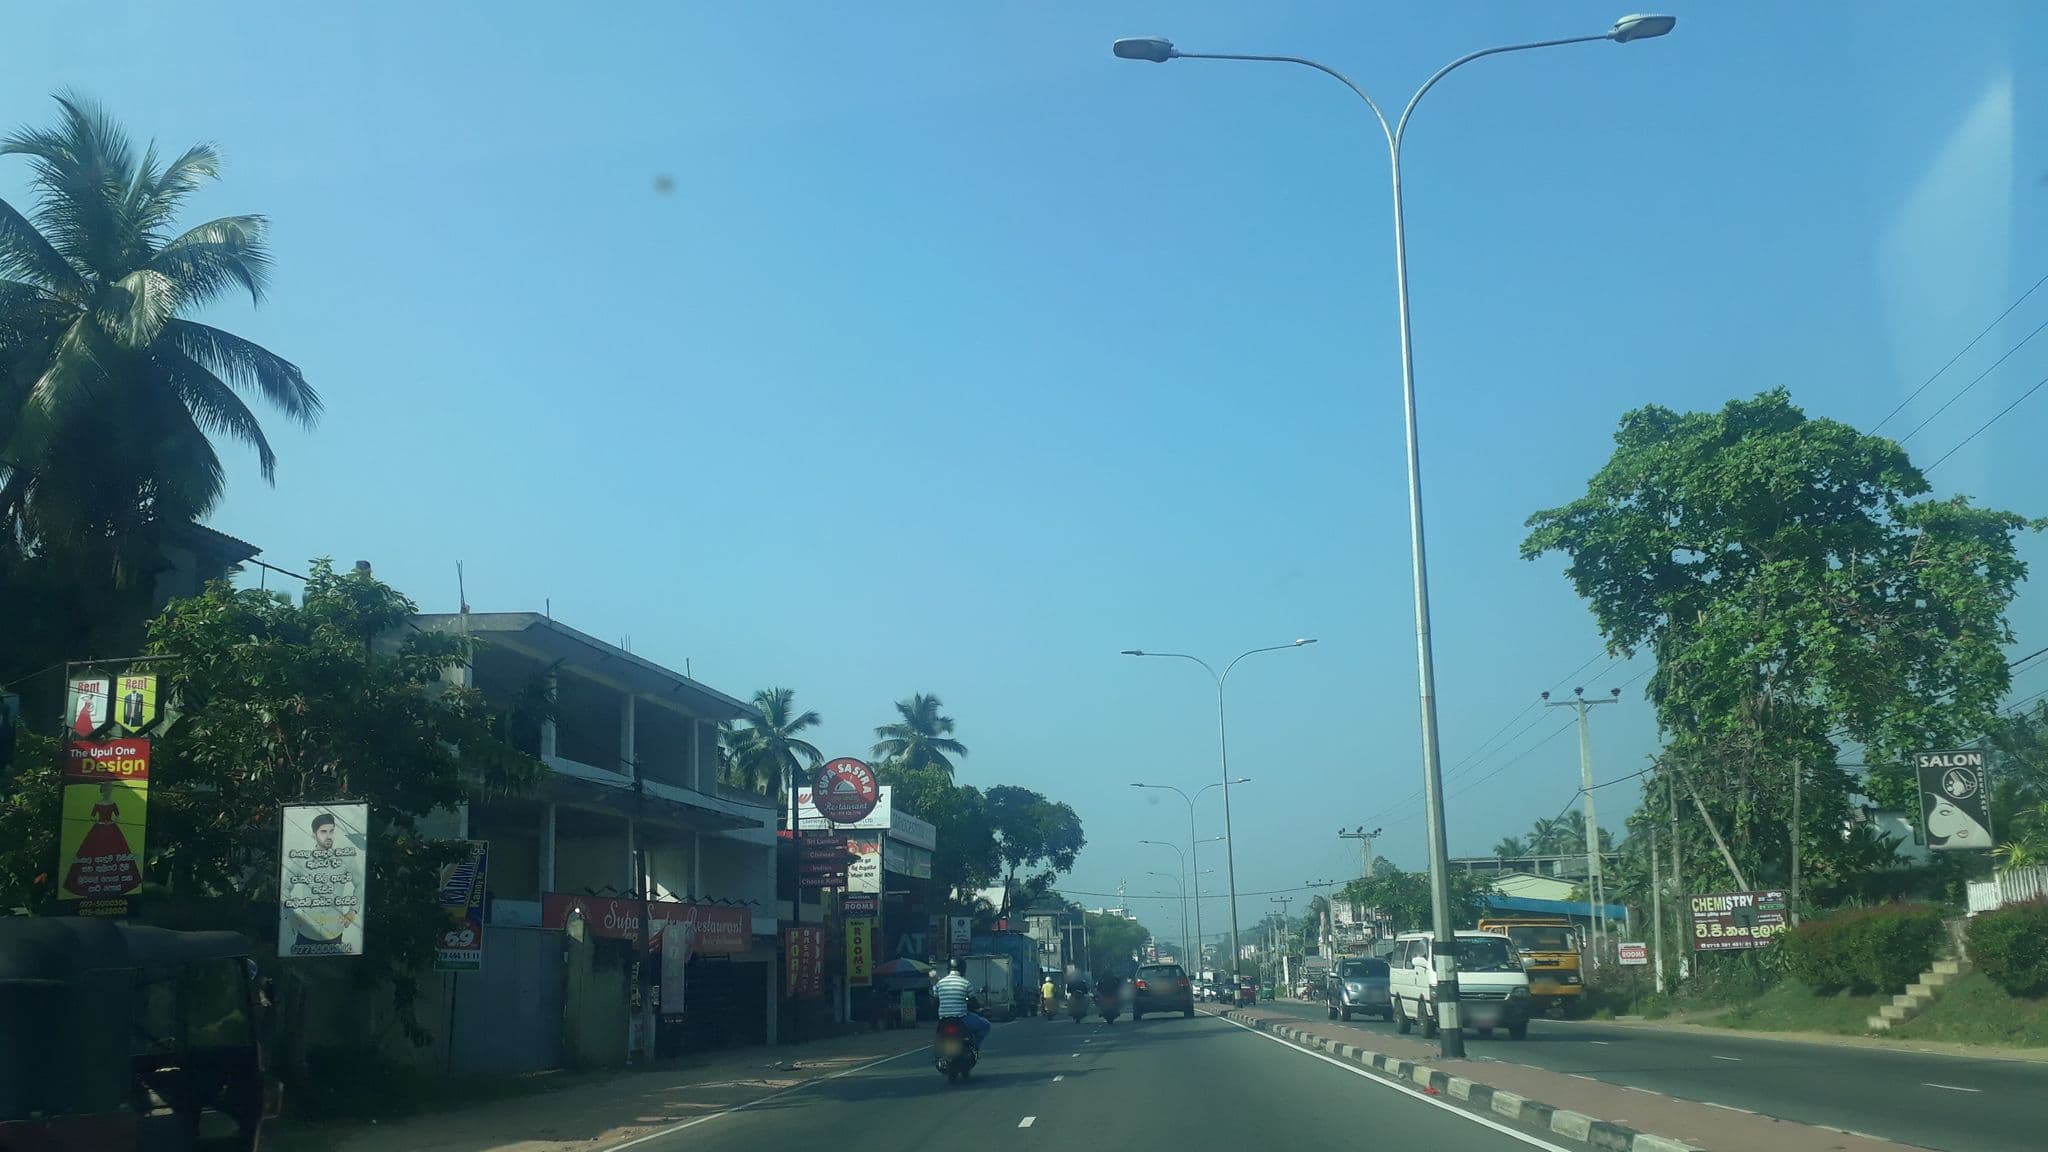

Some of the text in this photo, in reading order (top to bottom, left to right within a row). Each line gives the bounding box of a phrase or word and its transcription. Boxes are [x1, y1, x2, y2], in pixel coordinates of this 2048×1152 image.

[78, 681, 100, 693] Rent
[125, 678, 147, 690] Rent
[70, 746, 136, 758] The Upul One
[1920, 754, 1982, 767] SALON
[82, 757, 145, 775] Design
[819, 763, 872, 796] SUPA SASTRA
[1692, 895, 1754, 912] CHEMISTRY
[604, 901, 640, 934] Supa
[854, 927, 864, 974] ROOMS
